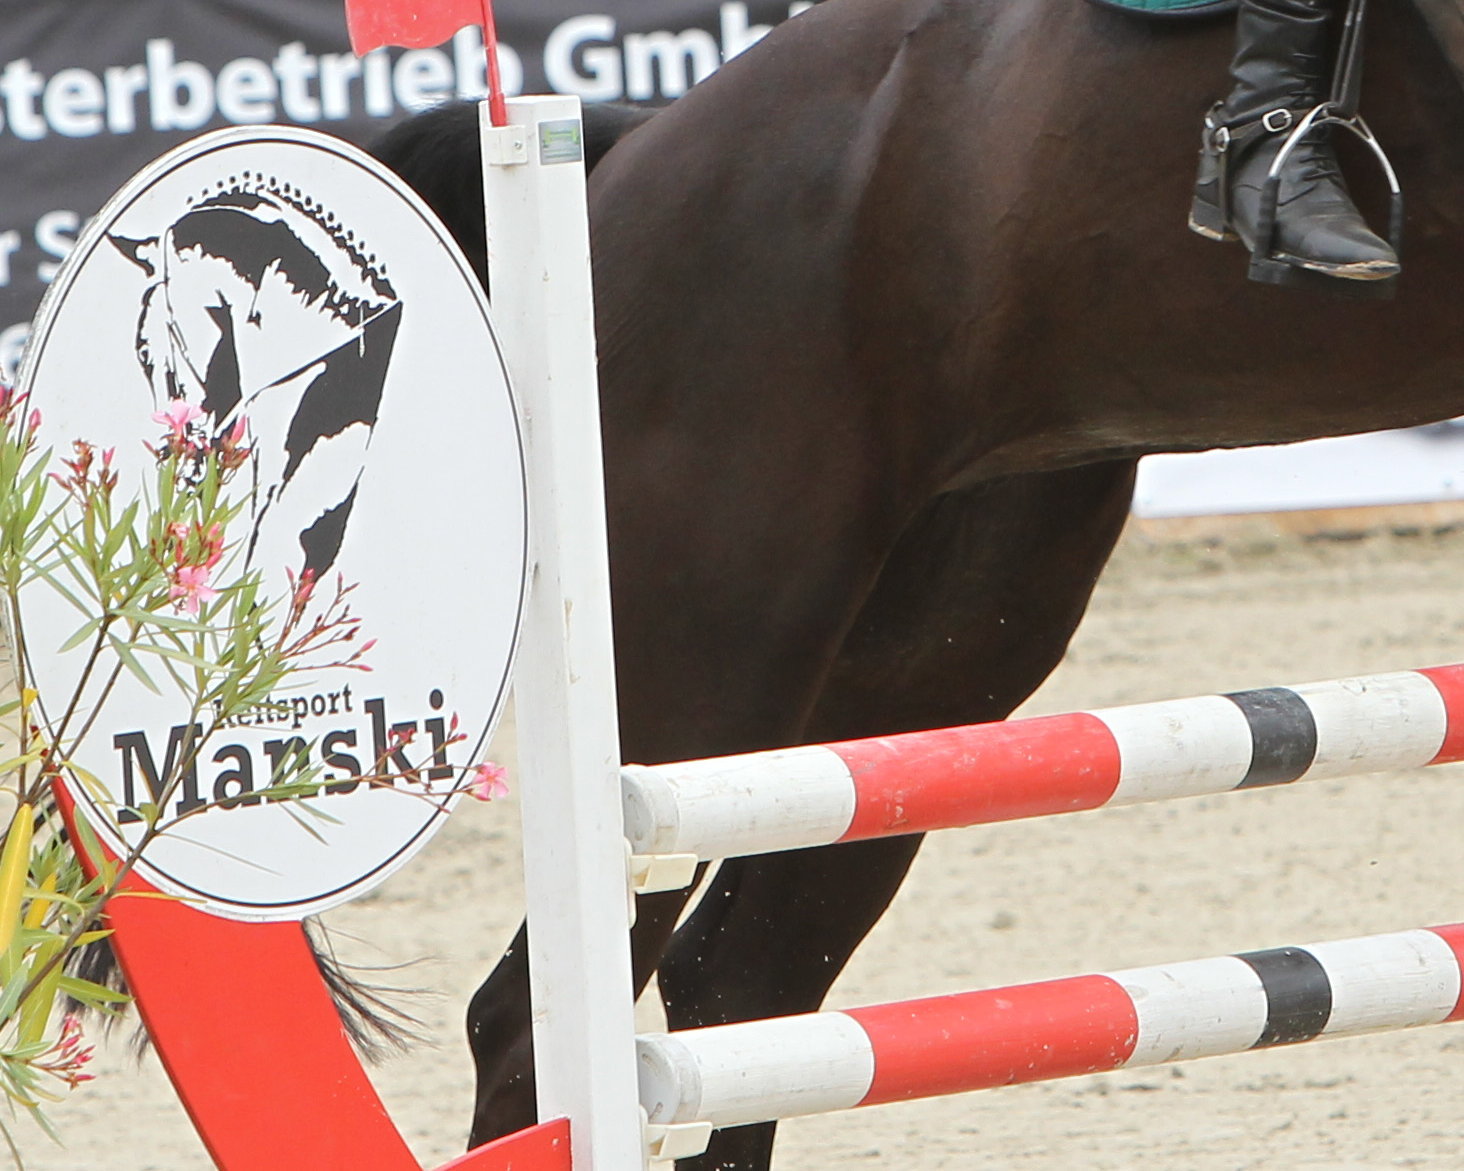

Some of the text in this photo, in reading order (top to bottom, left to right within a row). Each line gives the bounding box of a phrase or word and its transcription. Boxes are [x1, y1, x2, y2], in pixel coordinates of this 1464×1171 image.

[0, 1, 814, 140] terbetrieb Gm
[113, 688, 454, 825] Manski
